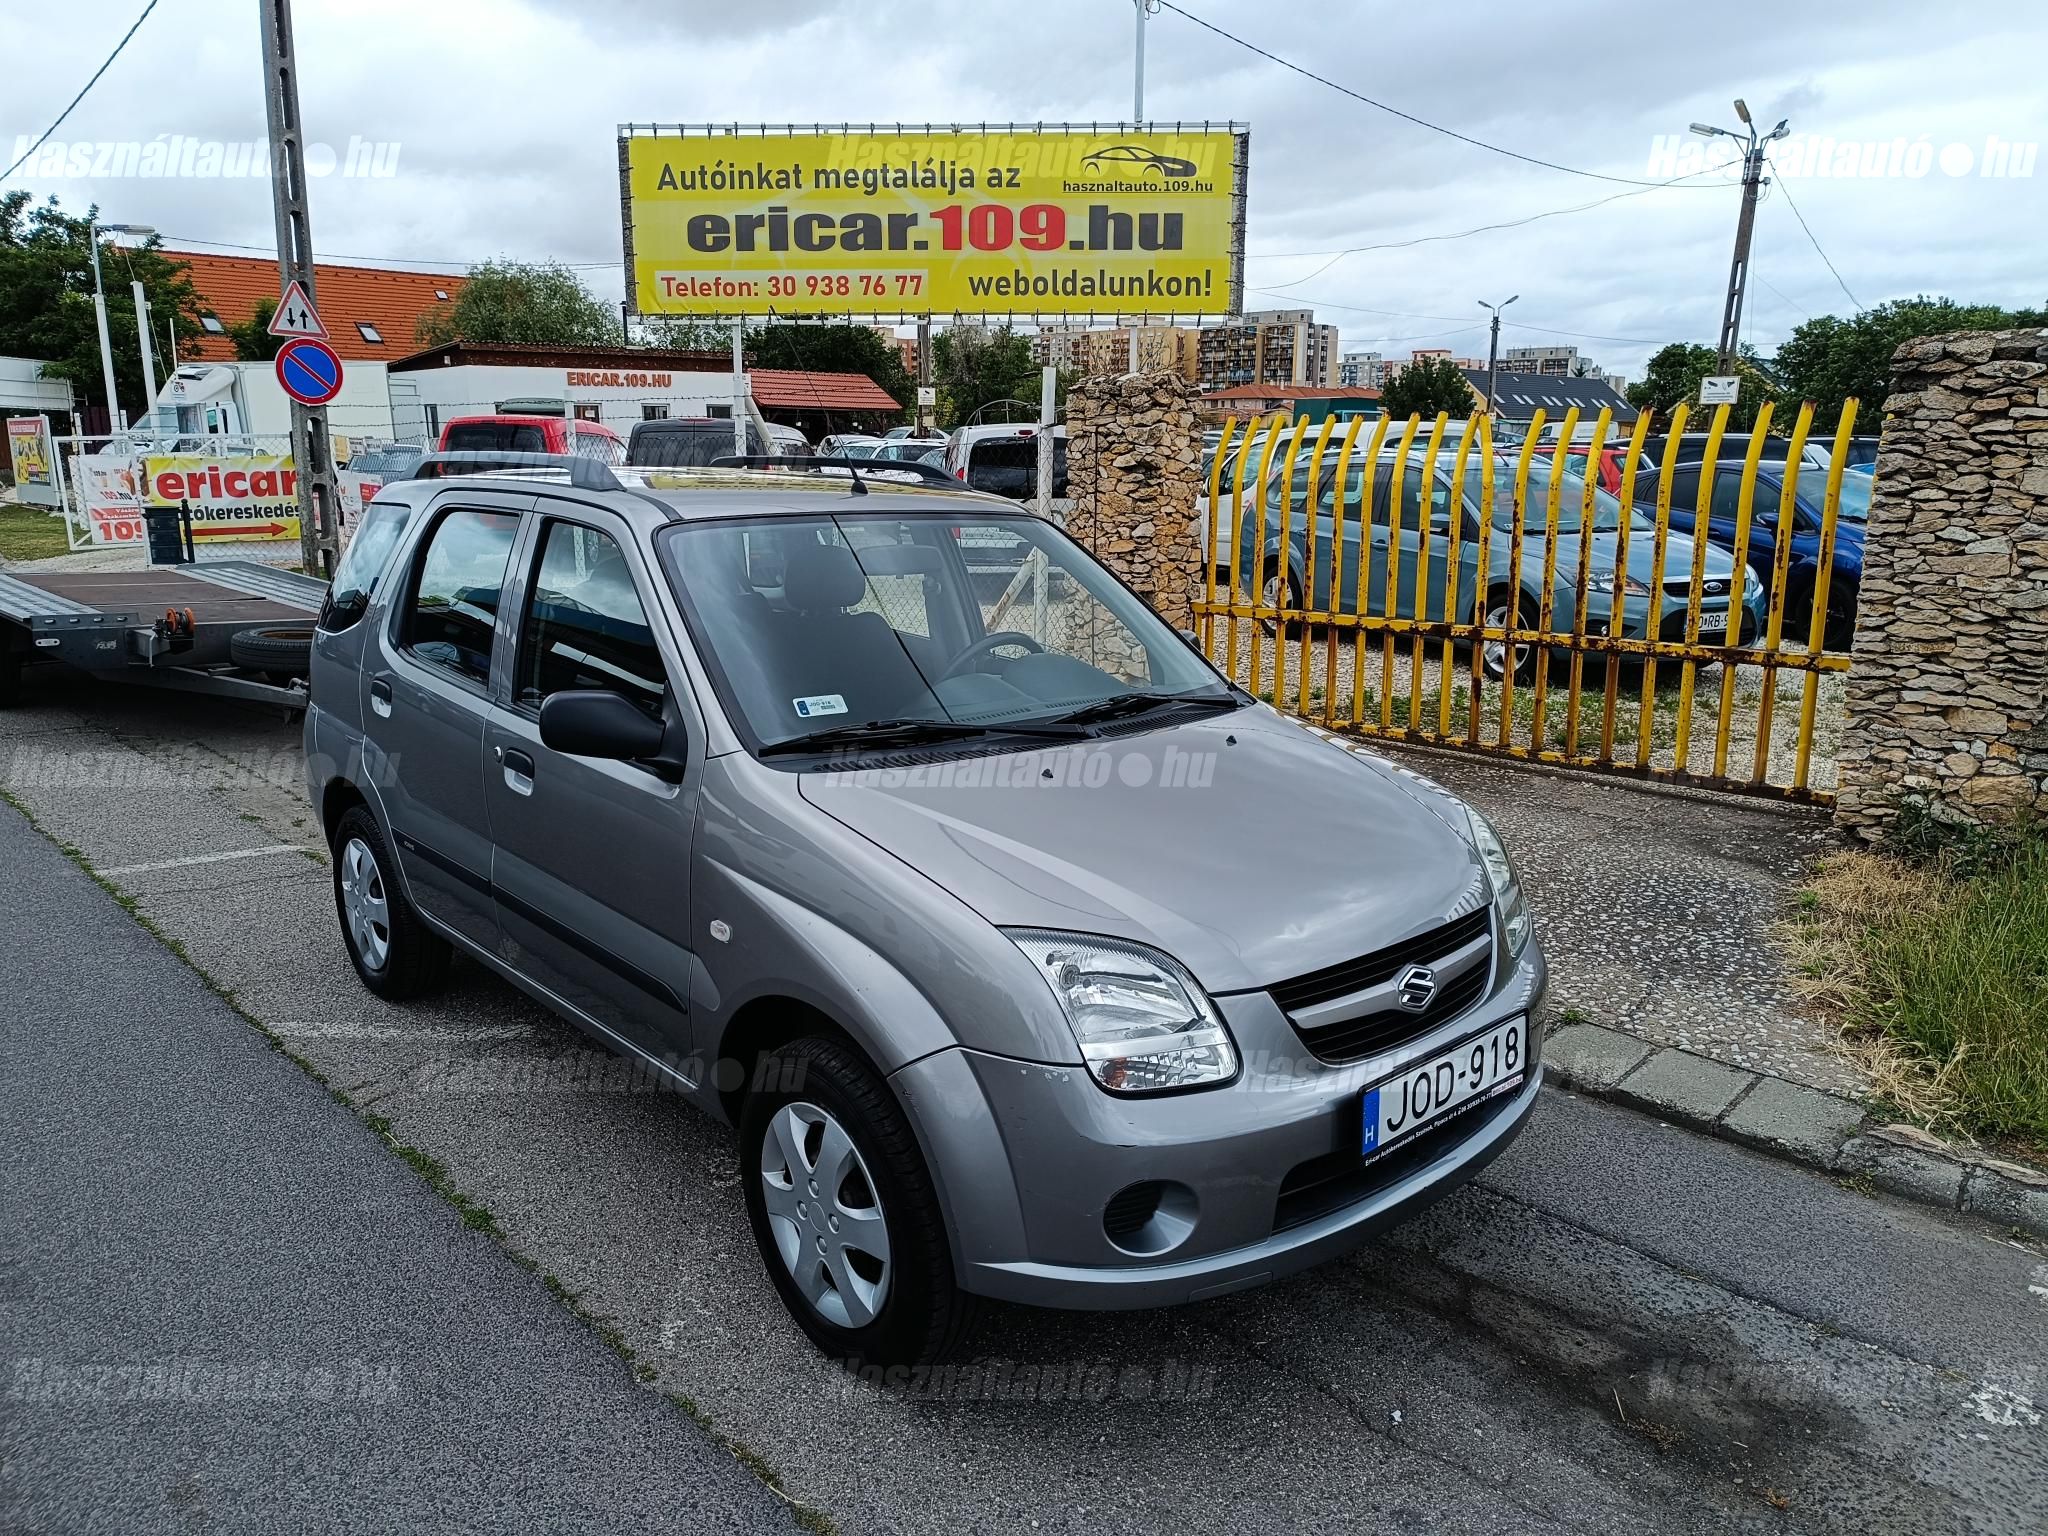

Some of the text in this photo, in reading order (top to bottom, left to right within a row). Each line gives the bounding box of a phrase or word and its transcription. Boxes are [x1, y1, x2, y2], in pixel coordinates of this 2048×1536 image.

[657, 156, 1021, 196] Autóinkat megtalálja az
[1062, 180, 1213, 192] hasznaltauto.109.hu
[686, 204, 1184, 253] ericar.109.hu
[660, 275, 923, 297] Telefon: 30 938 76 77
[968, 269, 1212, 297] weboldalunkon!
[566, 372, 672, 388] ERICAR.109.HU
[100, 491, 133, 500] 109.hu
[156, 466, 297, 500] ericar
[1386, 1026, 1519, 1132] JOD-918
